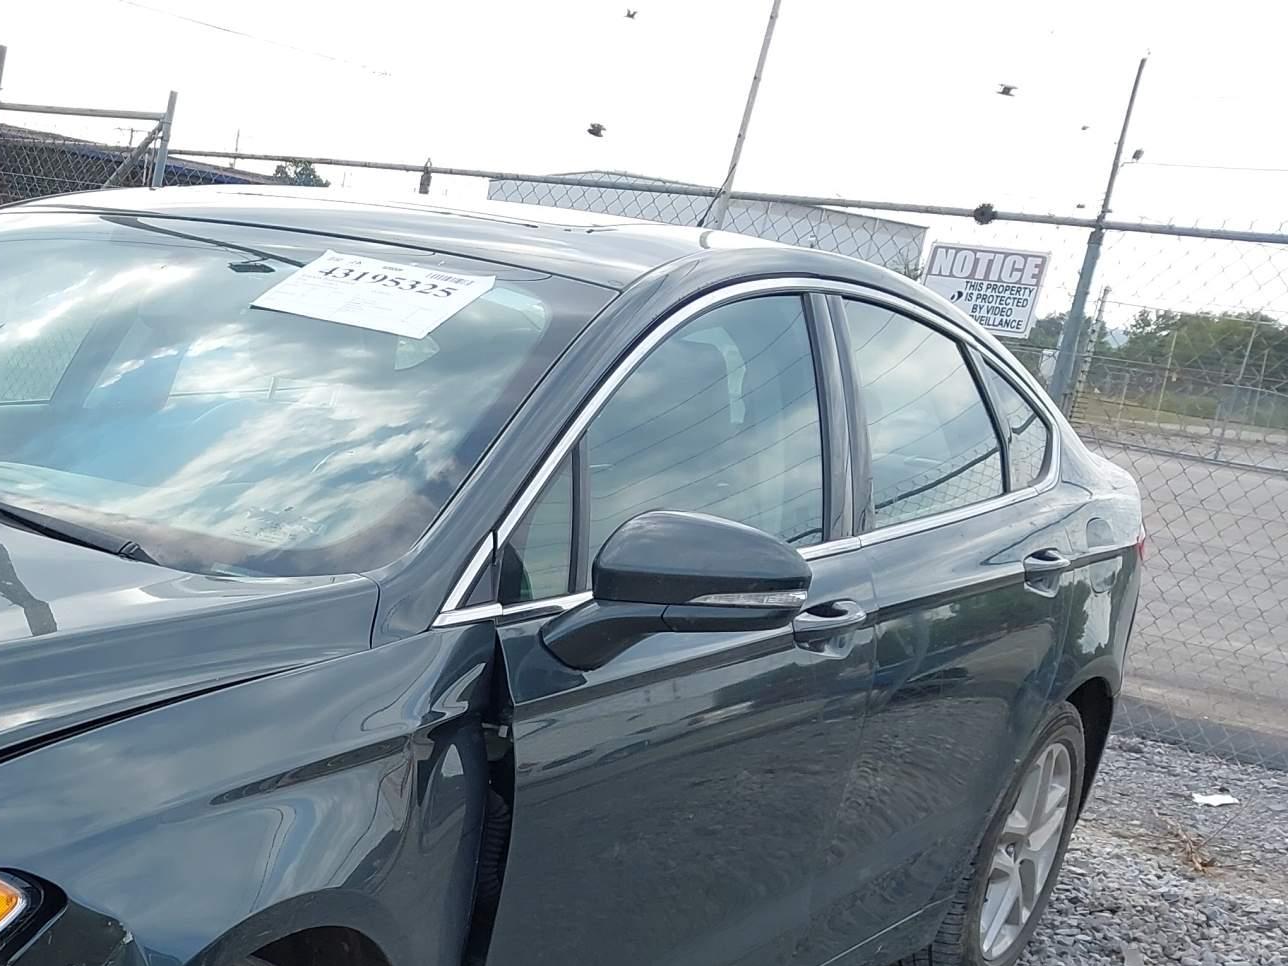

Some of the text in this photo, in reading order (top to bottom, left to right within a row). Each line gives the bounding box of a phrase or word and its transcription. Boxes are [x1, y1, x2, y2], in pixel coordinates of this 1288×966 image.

[931, 247, 1042, 285] NOTICE
[318, 266, 459, 298] 43195325
[964, 280, 1035, 297] THIS PROPERTY
[964, 291, 1029, 308] IS PROTECTED
[971, 304, 1013, 317] BY VIDEO
[969, 314, 1023, 330] VEILLANCE
